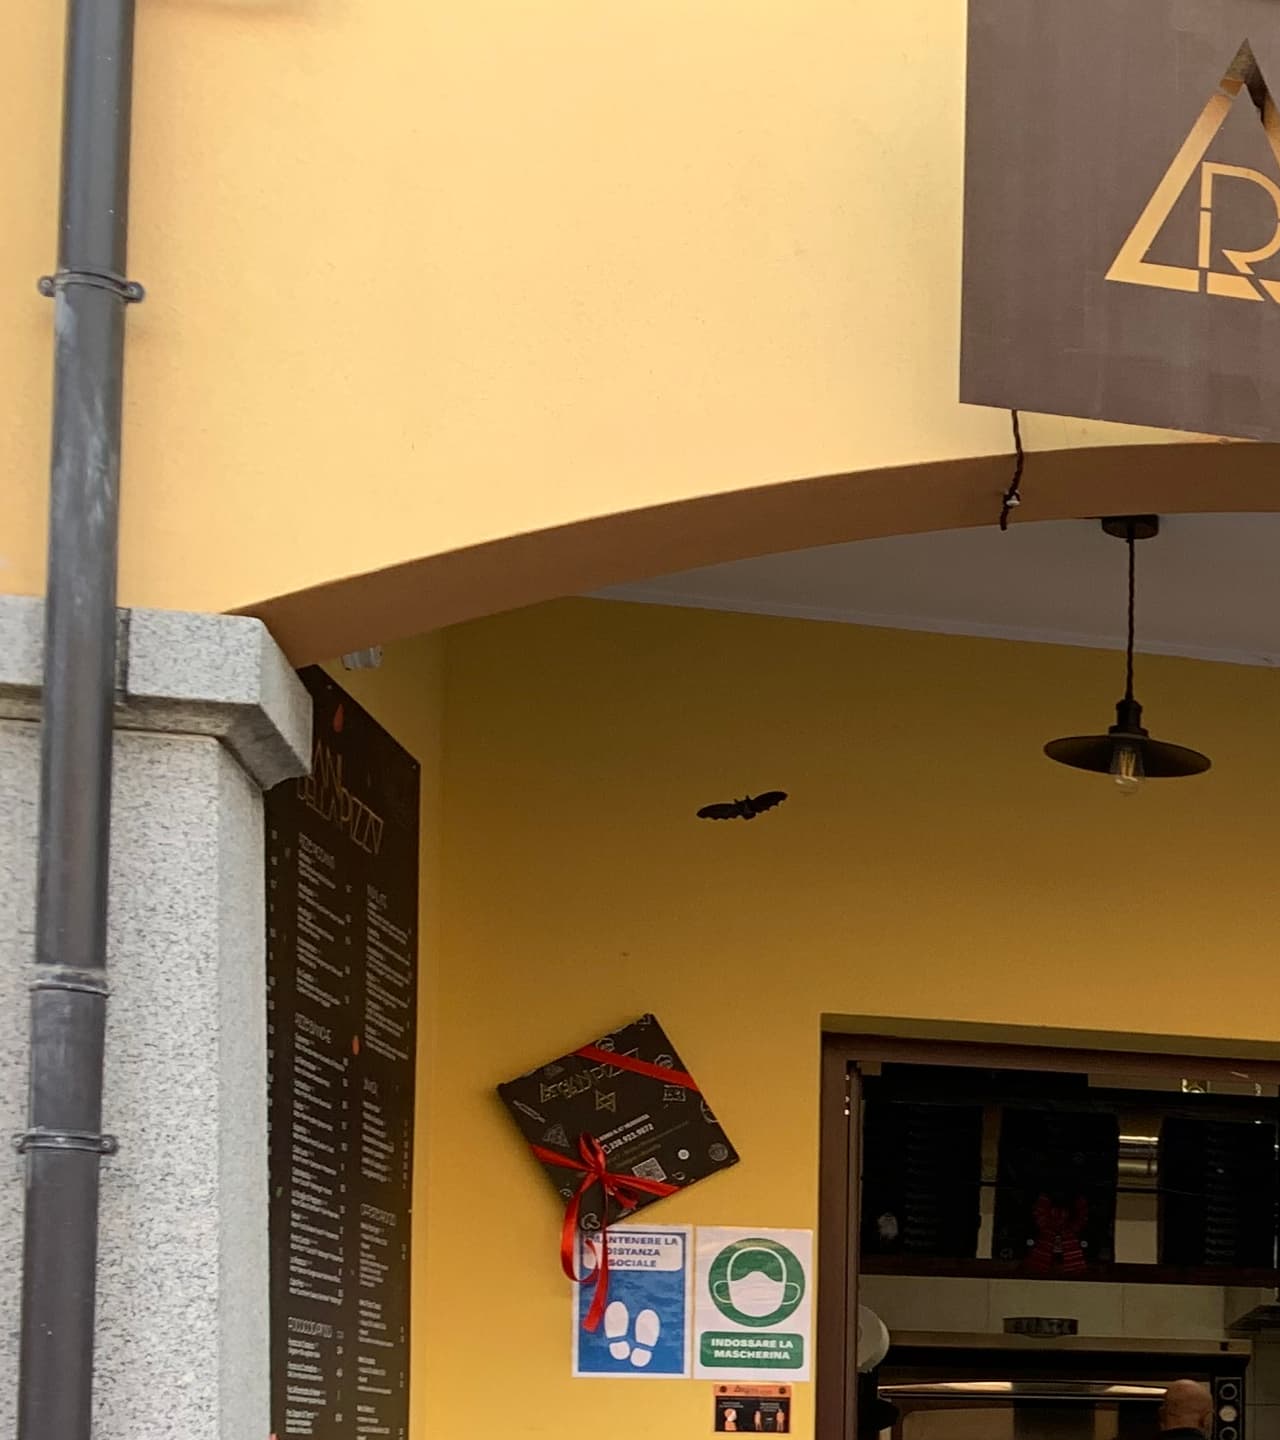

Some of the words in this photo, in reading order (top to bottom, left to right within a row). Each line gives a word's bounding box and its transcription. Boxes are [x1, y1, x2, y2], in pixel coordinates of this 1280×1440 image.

[593, 1233, 661, 1245] MNTENERE
[664, 1236, 678, 1246] LA
[608, 1259, 657, 1268] SOCIALE
[710, 1338, 777, 1348] INDOSSARE
[779, 1340, 794, 1349] LA
[713, 1349, 791, 1360] MASCHERINA
